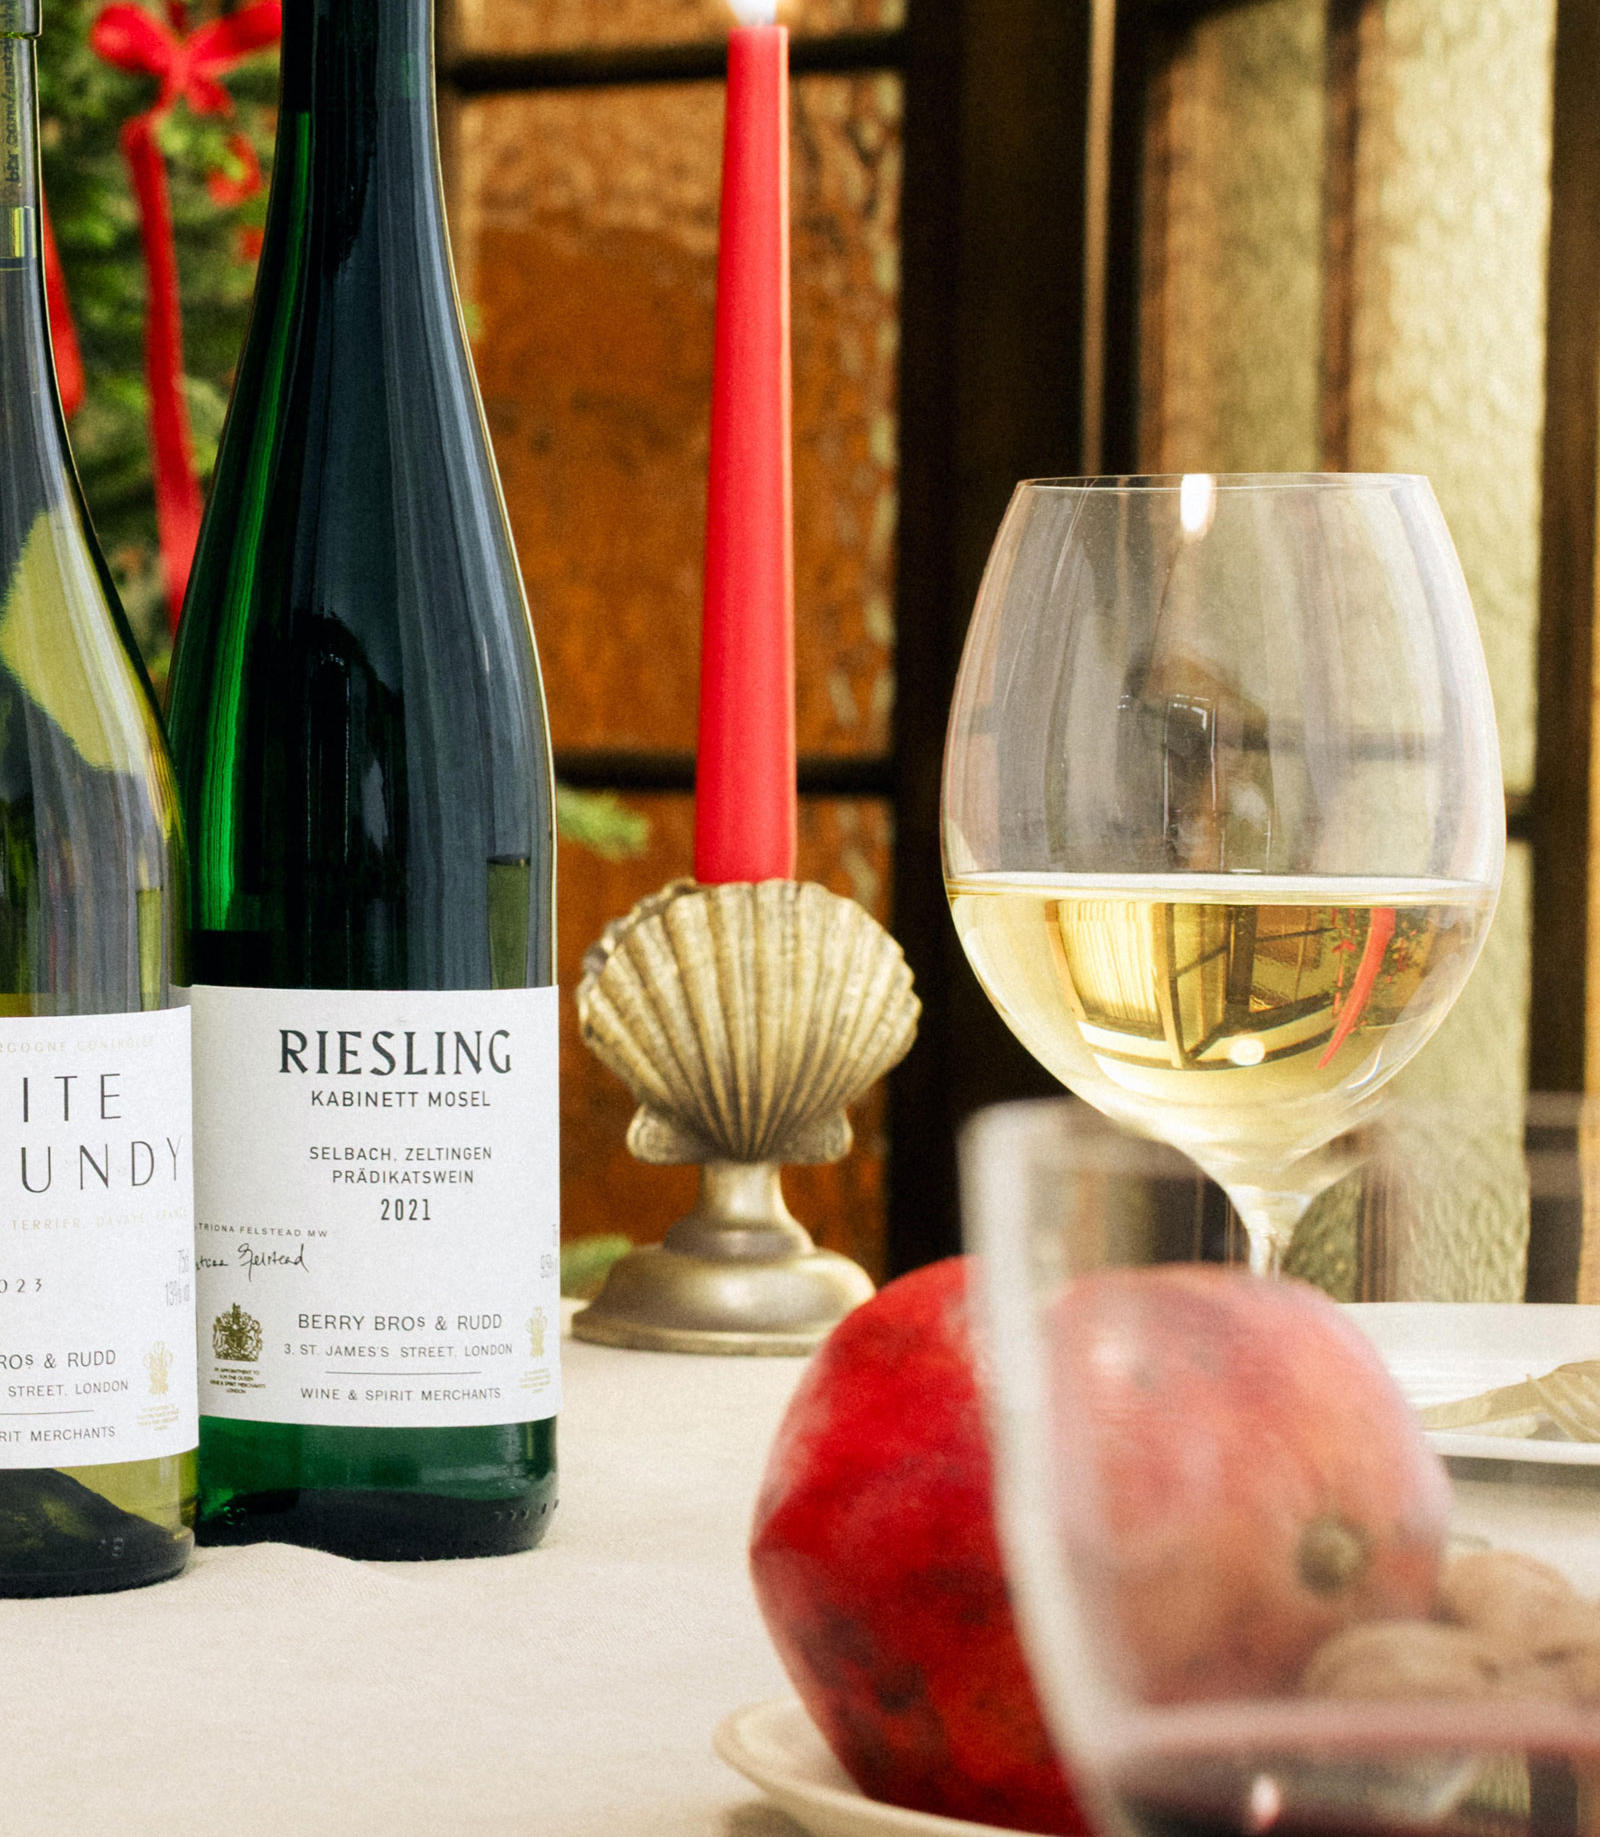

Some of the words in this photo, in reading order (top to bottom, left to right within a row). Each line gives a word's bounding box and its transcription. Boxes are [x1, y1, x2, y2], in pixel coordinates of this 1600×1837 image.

[278, 1028, 512, 1077] RIESLING
[311, 1089, 419, 1108] KABINETT
[428, 1090, 491, 1108] MOSEL
[404, 1146, 492, 1162] ZELTINGEN
[332, 1167, 474, 1185] PRÄDIKATSWEIN
[380, 1197, 432, 1222] 2021
[194, 1222, 235, 1233] TRIONA
[240, 1226, 302, 1237] FELSTEAD
[307, 1230, 328, 1238] MW
[298, 1313, 365, 1331] BERRY
[434, 1315, 448, 1332] &
[457, 1313, 503, 1331] RUDD
[43, 1352, 57, 1370] &
[67, 1349, 117, 1368] RUDD
[325, 1344, 390, 1358] JAMES'S
[464, 1343, 513, 1358] LONDON
[75, 1379, 129, 1396] LONDON
[299, 1387, 341, 1401] WINE
[347, 1389, 358, 1401] &
[364, 1389, 414, 1402] SPIRIT
[420, 1387, 501, 1402] MERCHANTS
[30, 1425, 116, 1443] MERCHANTS
